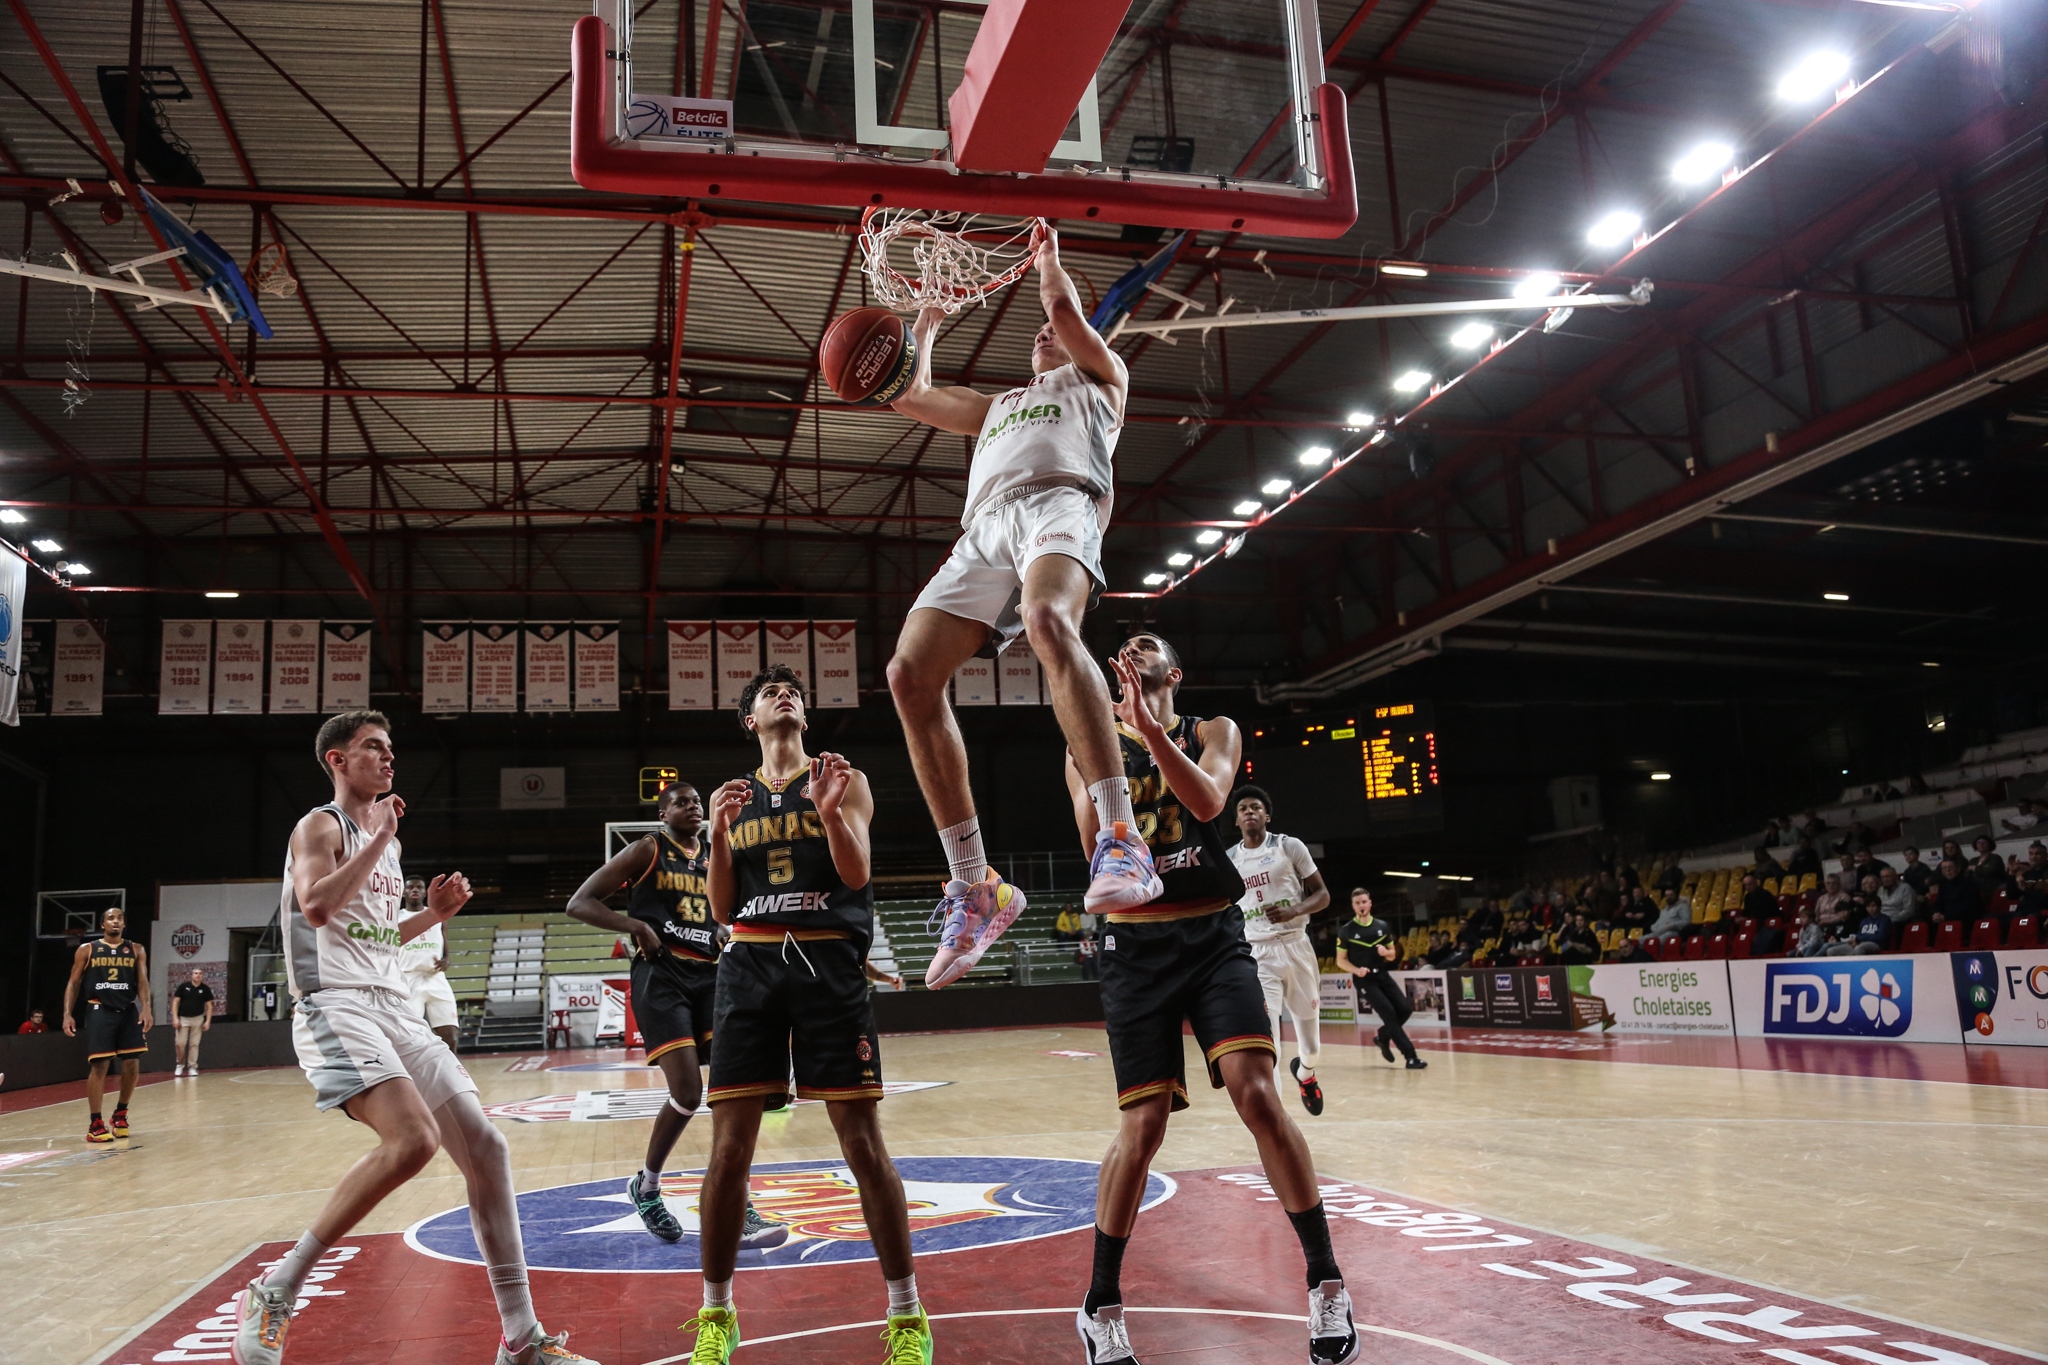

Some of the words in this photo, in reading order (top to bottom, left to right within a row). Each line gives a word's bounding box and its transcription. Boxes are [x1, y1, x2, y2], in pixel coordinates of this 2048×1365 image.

[676, 111, 724, 125] Betclic
[859, 334, 896, 388] LEGACY
[871, 341, 915, 402] SPALDING
[171, 667, 200, 675] 1991
[225, 673, 254, 681] 1994
[281, 667, 309, 675] 1994
[332, 673, 361, 681] 2008
[678, 671, 704, 679] 1986
[824, 670, 849, 678] 2008
[962, 668, 987, 676] 2010
[1006, 668, 1031, 676] 2010
[64, 674, 93, 682] 1991
[171, 677, 200, 685] 1992
[280, 677, 309, 685] 2008
[527, 780, 538, 791] U
[727, 810, 828, 850] MONAC
[1135, 804, 1183, 847] 23
[766, 846, 795, 885] 5
[655, 870, 707, 895] MONA
[1256, 890, 1263, 902] 9
[386, 900, 393, 921] 11
[676, 896, 707, 924] 43
[663, 920, 712, 945] SKWEEK
[1861, 923, 1878, 934] GAP
[171, 932, 205, 946] CHOLET
[91, 956, 135, 968] MONACO
[107, 968, 118, 981] 2
[1969, 964, 1981, 975] M
[95, 982, 129, 990] SKWEEK
[1639, 968, 1698, 993] Energies
[569, 995, 600, 1007] ROU
[1771, 973, 1851, 1024] FDJ
[1974, 991, 1986, 1002] M
[1633, 997, 1712, 1016] Choletaises
[1980, 1018, 1989, 1030] A
